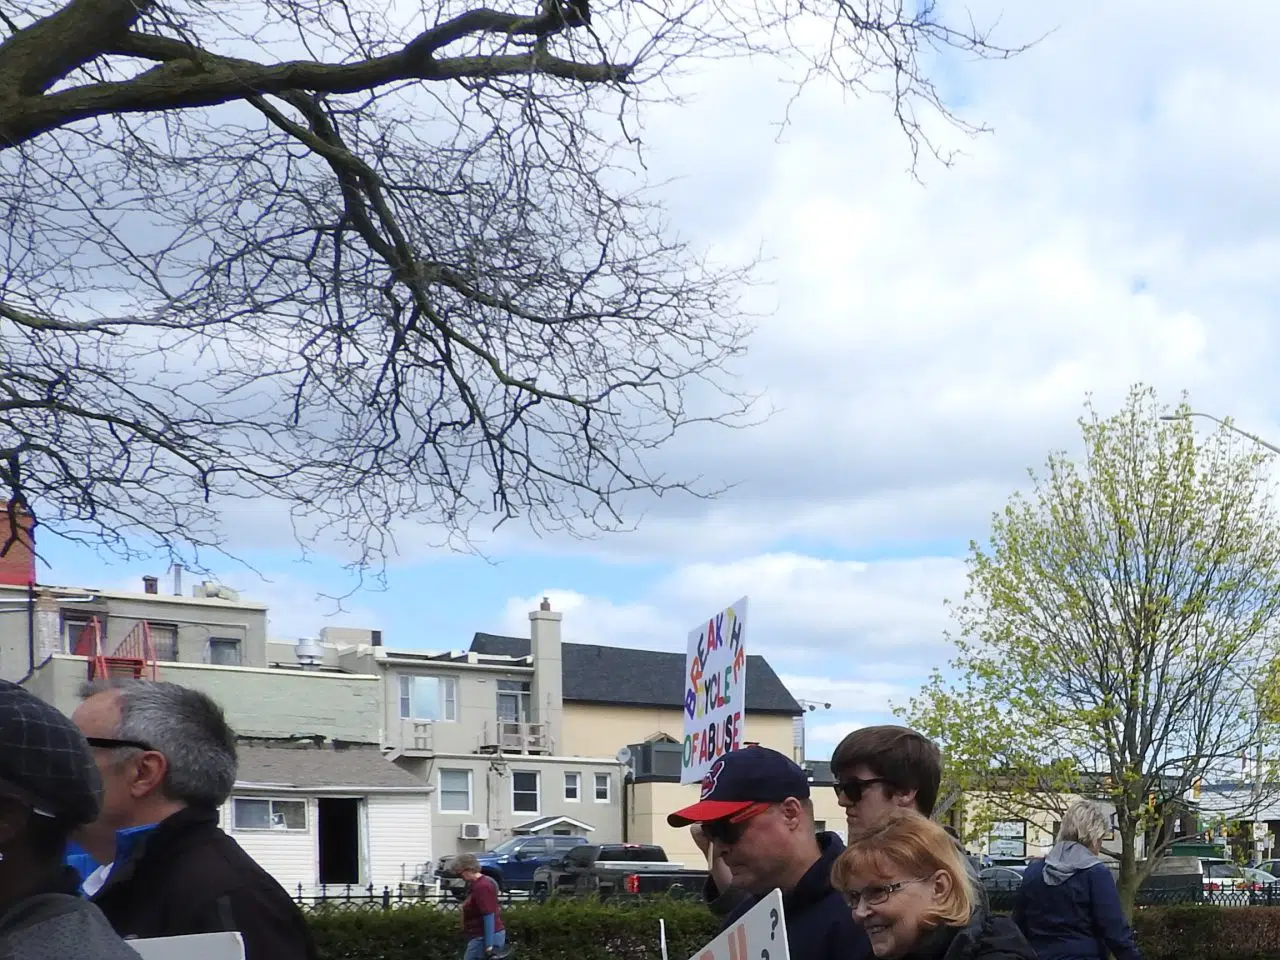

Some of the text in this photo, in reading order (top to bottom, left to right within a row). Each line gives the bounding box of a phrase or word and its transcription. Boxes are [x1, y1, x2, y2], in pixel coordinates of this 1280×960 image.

[684, 607, 744, 720] BREAK THE
[696, 666, 732, 719] CYCLE
[683, 712, 740, 768] OF ABUSE
